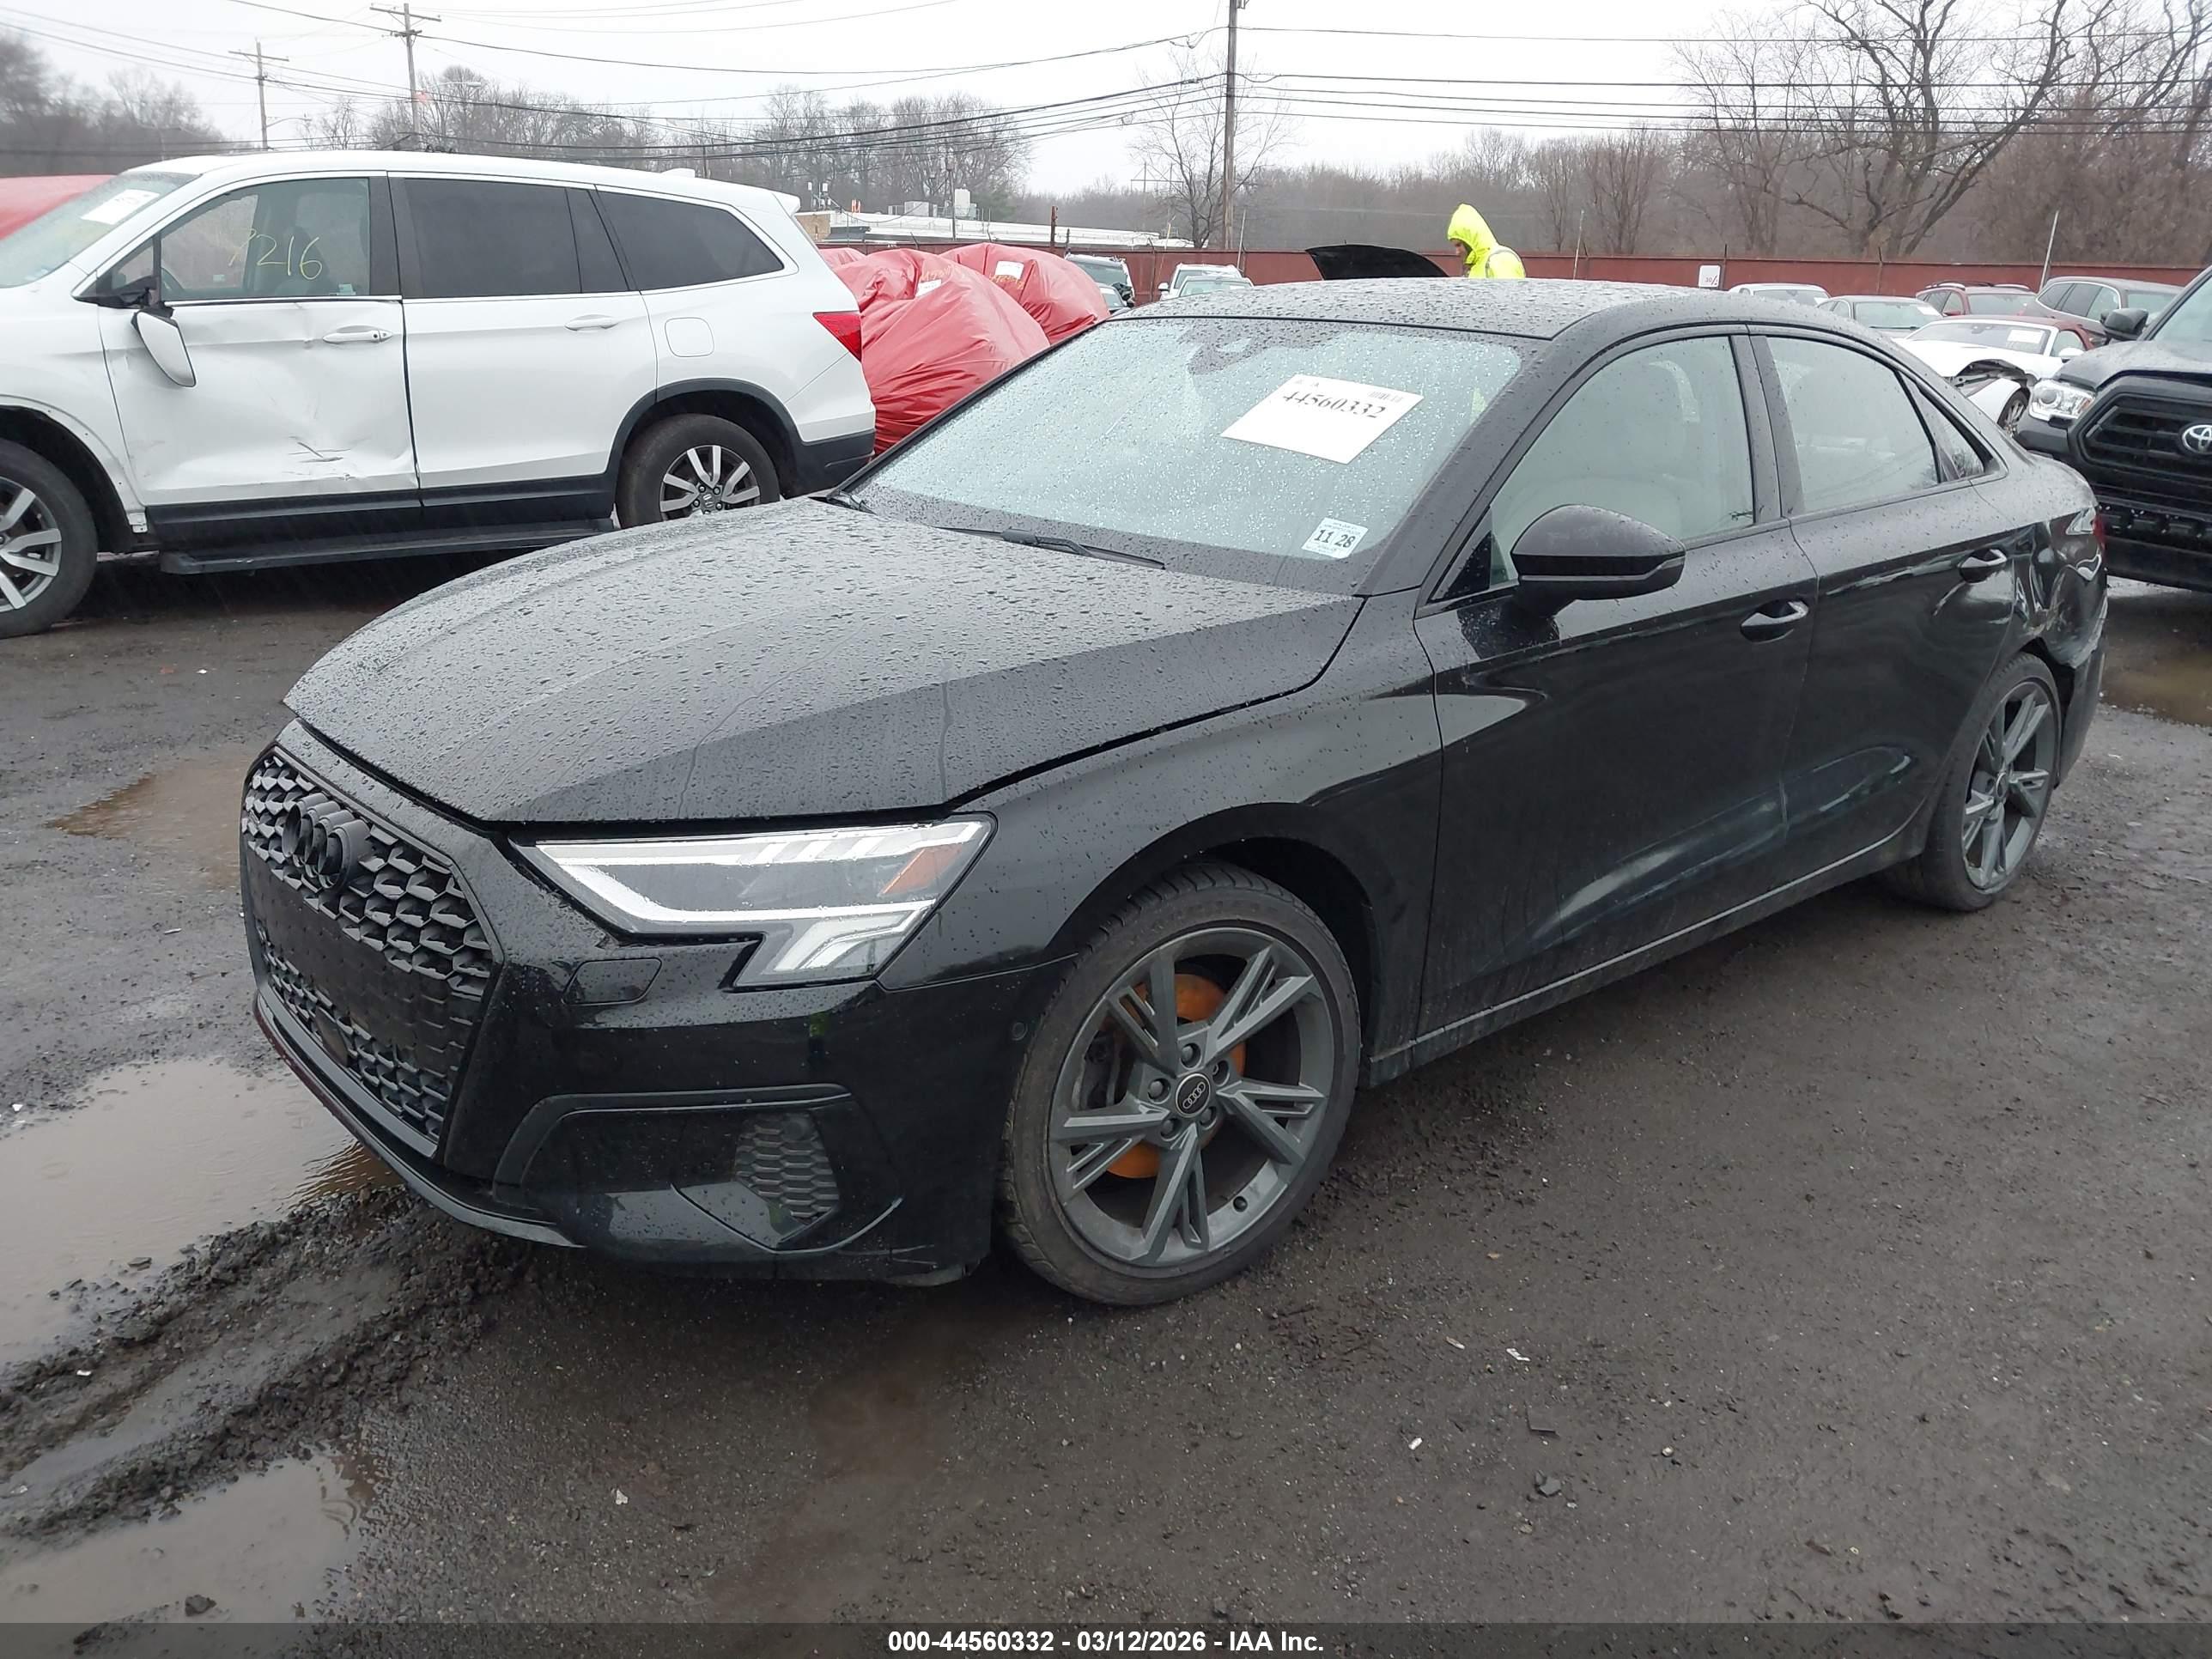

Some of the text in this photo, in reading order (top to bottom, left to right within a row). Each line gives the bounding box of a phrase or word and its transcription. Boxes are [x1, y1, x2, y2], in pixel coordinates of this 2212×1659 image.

[1282, 391, 1387, 418] 44560332
[1314, 529, 1334, 544] 11
[1334, 533, 1356, 548] 28
